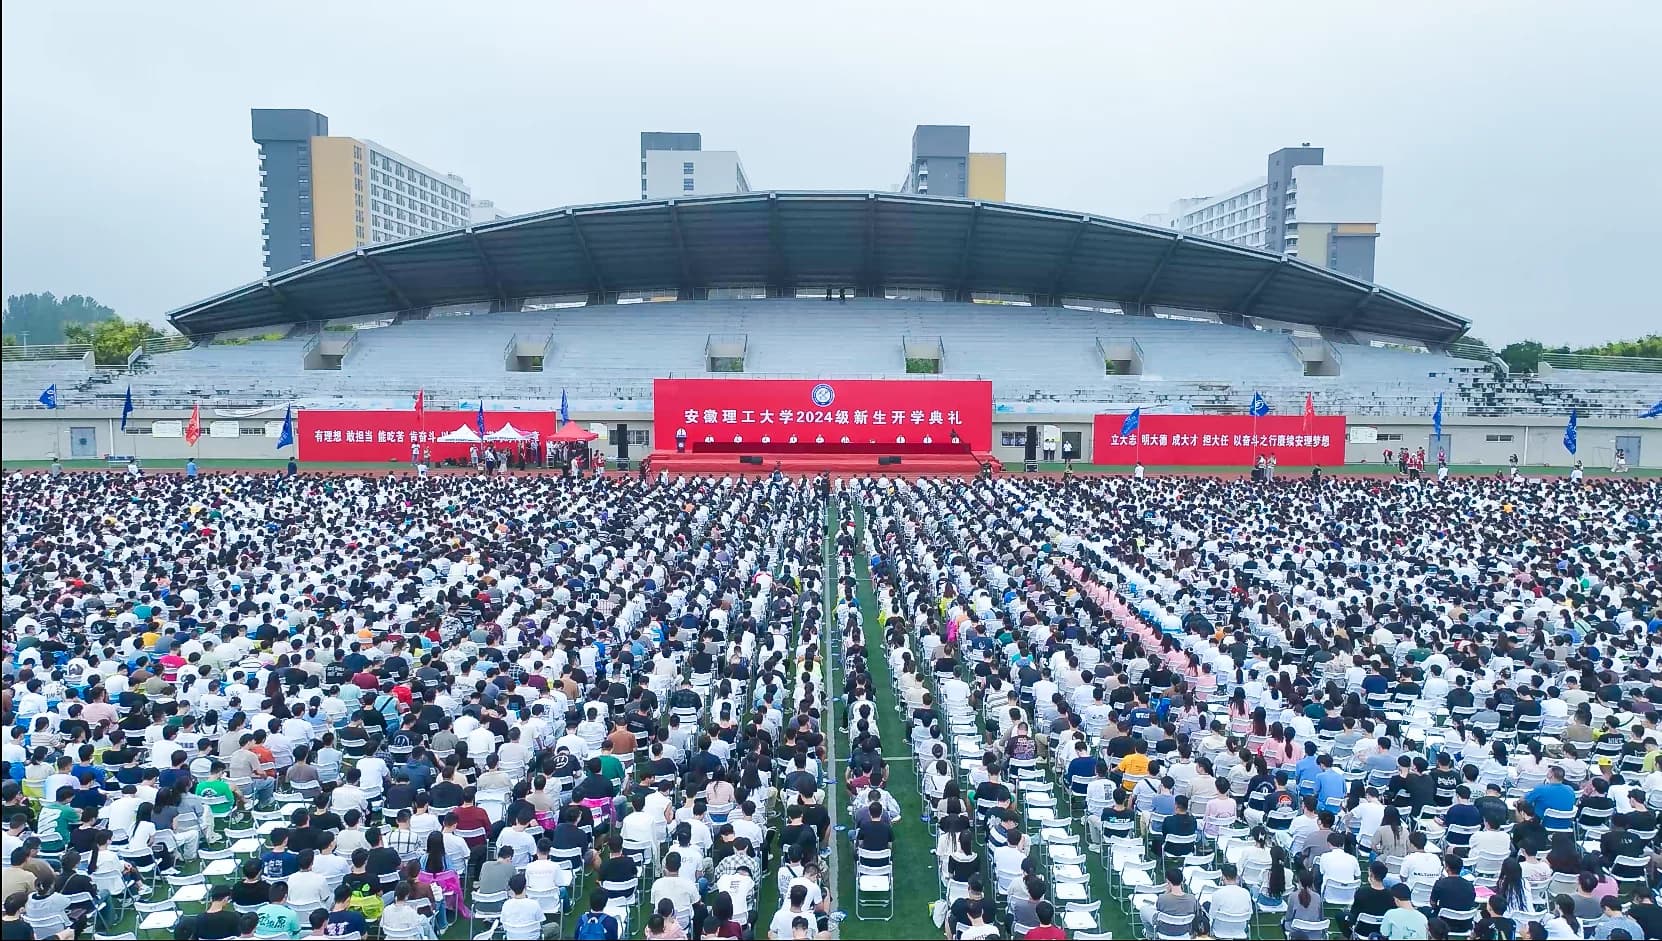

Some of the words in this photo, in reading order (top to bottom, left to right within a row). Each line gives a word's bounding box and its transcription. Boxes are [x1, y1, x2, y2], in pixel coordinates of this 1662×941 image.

[684, 409, 962, 425] 安徽理工大学2024级新生开学典礼
[314, 429, 342, 443] 有理想
[346, 429, 373, 443] 敢担当
[377, 429, 405, 443] 能吃苦
[409, 430, 436, 443] 肯奋斗
[1110, 434, 1137, 446] 立大志
[1141, 434, 1168, 446] 明大德
[1172, 434, 1198, 446] 成大才
[1202, 434, 1229, 447] 担大任
[1233, 434, 1330, 447] 以奋斗之行赓续安理梦想
